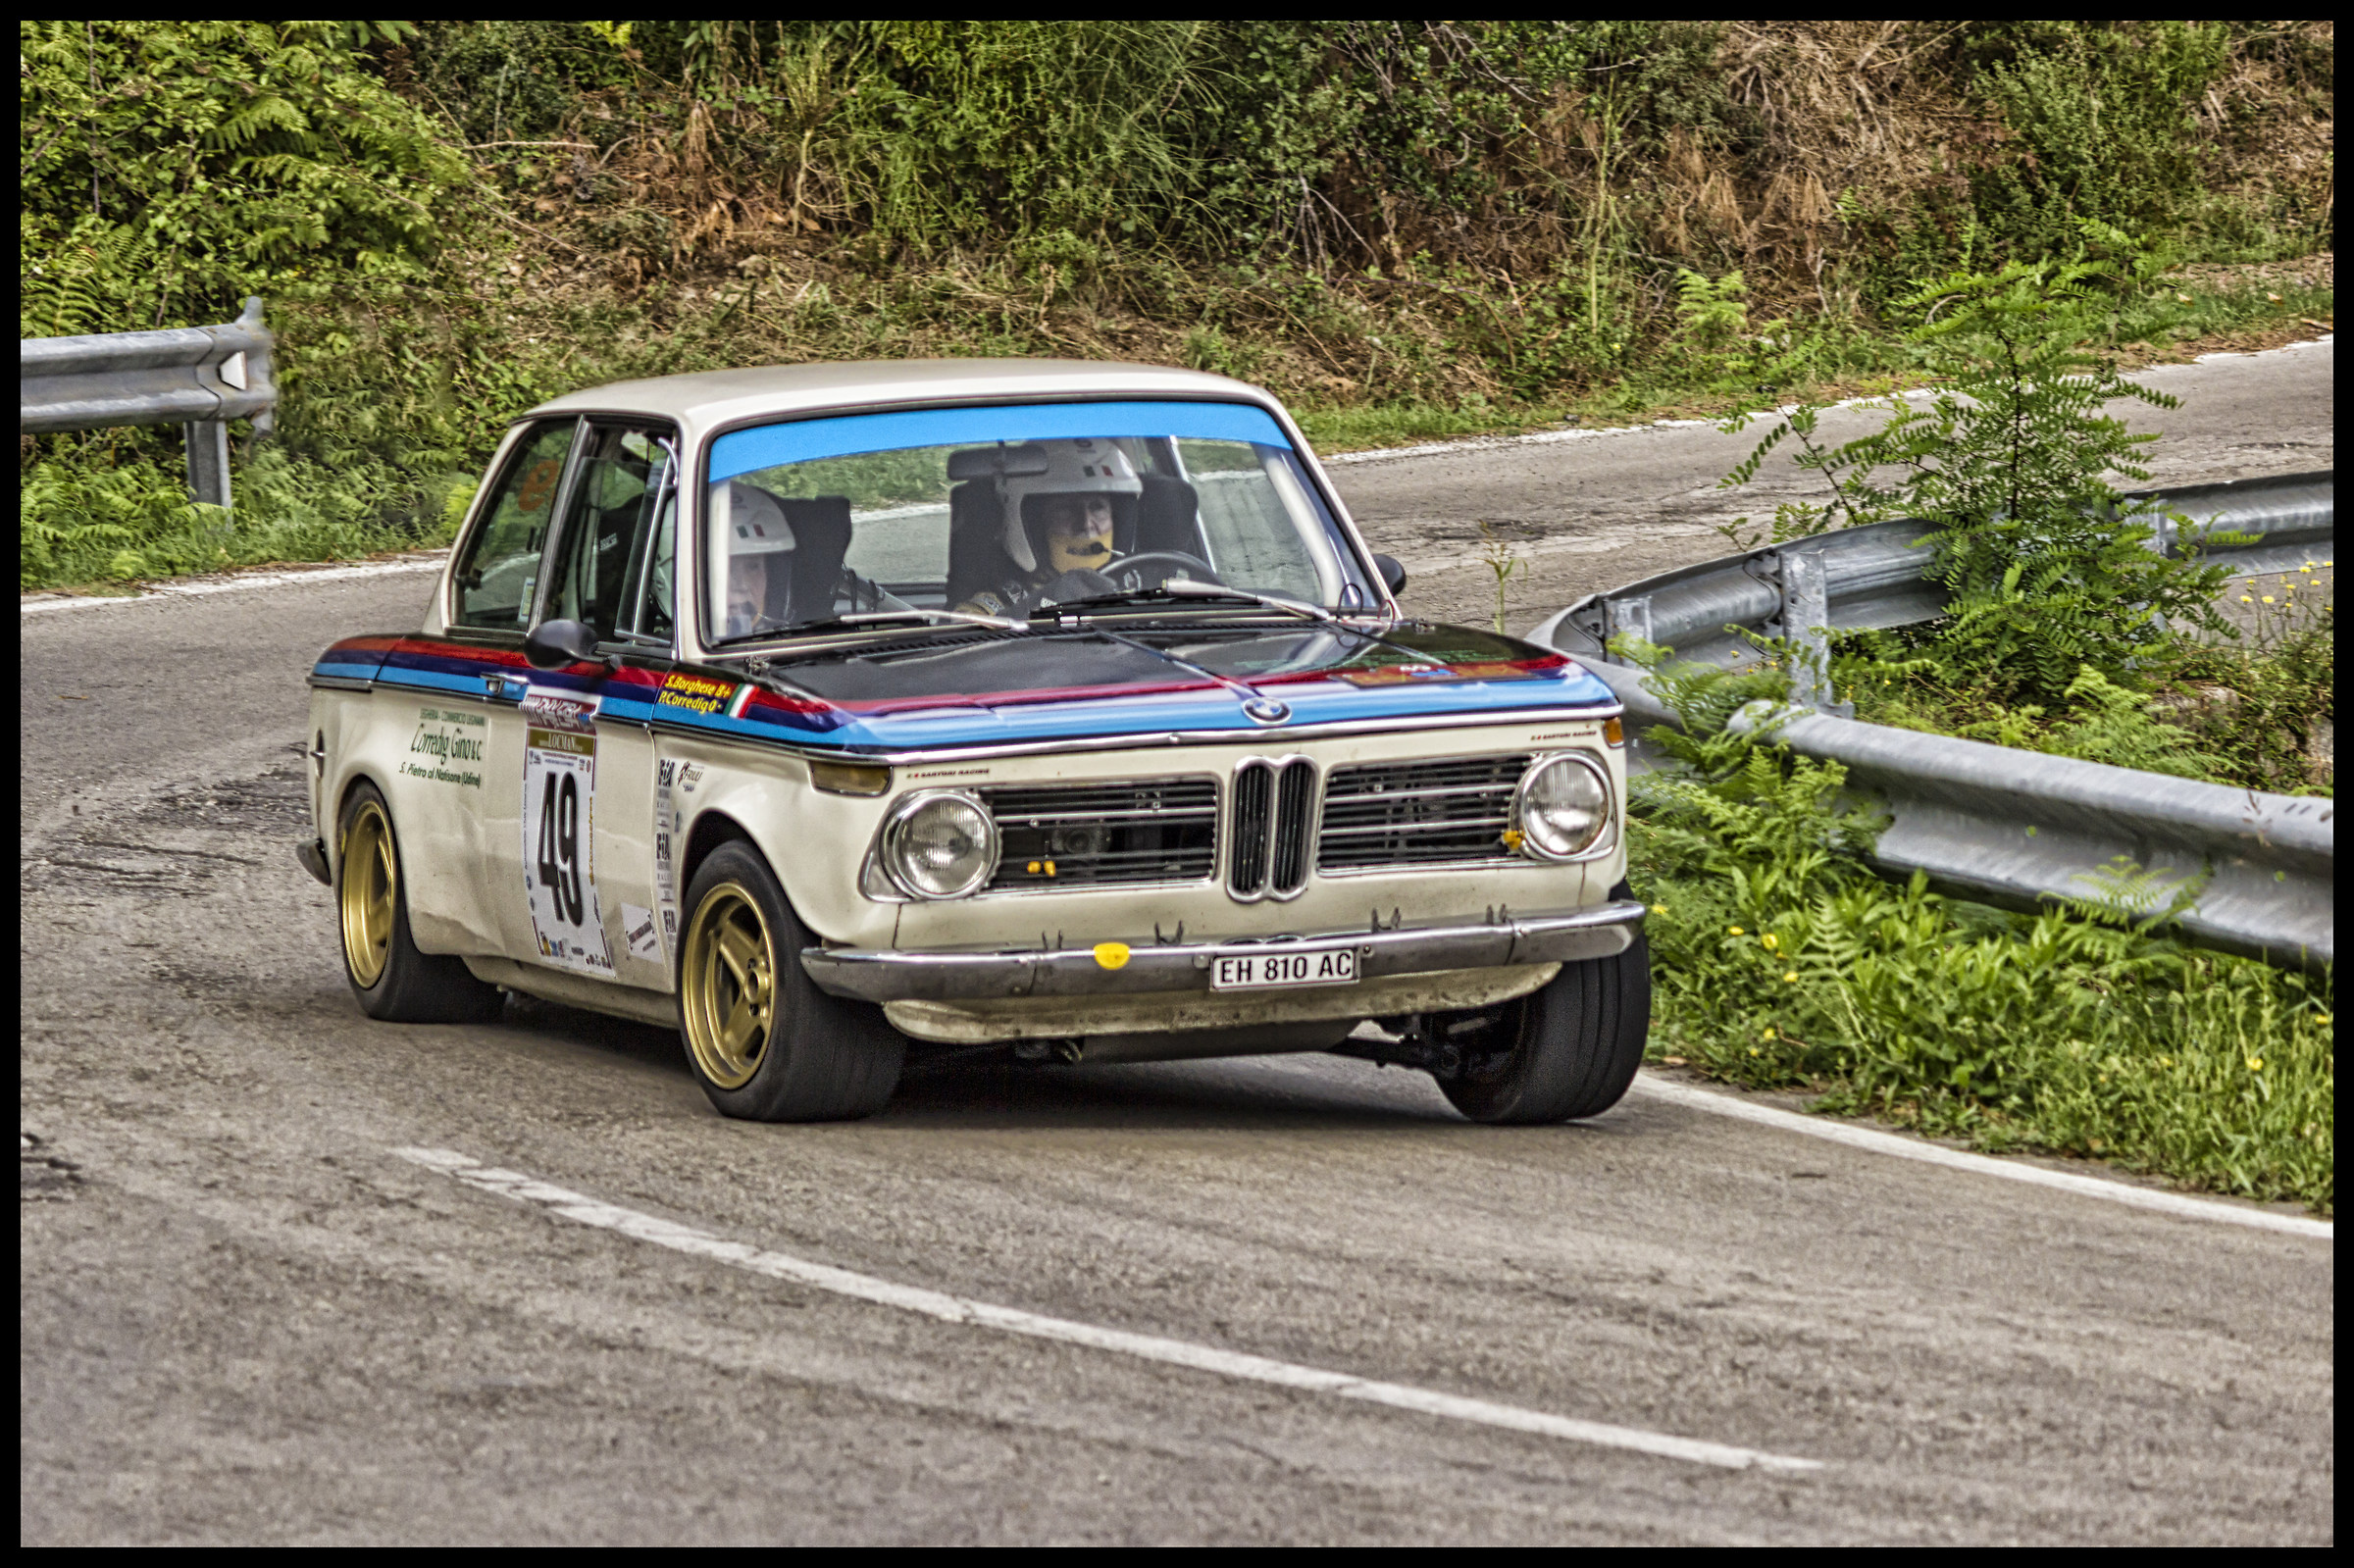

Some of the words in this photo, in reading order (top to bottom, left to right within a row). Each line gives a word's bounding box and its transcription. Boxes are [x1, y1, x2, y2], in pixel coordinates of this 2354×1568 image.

[407, 763, 428, 779] Pietro
[537, 772, 584, 927] 49
[1220, 959, 1253, 983] EH
[1264, 956, 1307, 981] 810
[1318, 952, 1352, 977] AC
